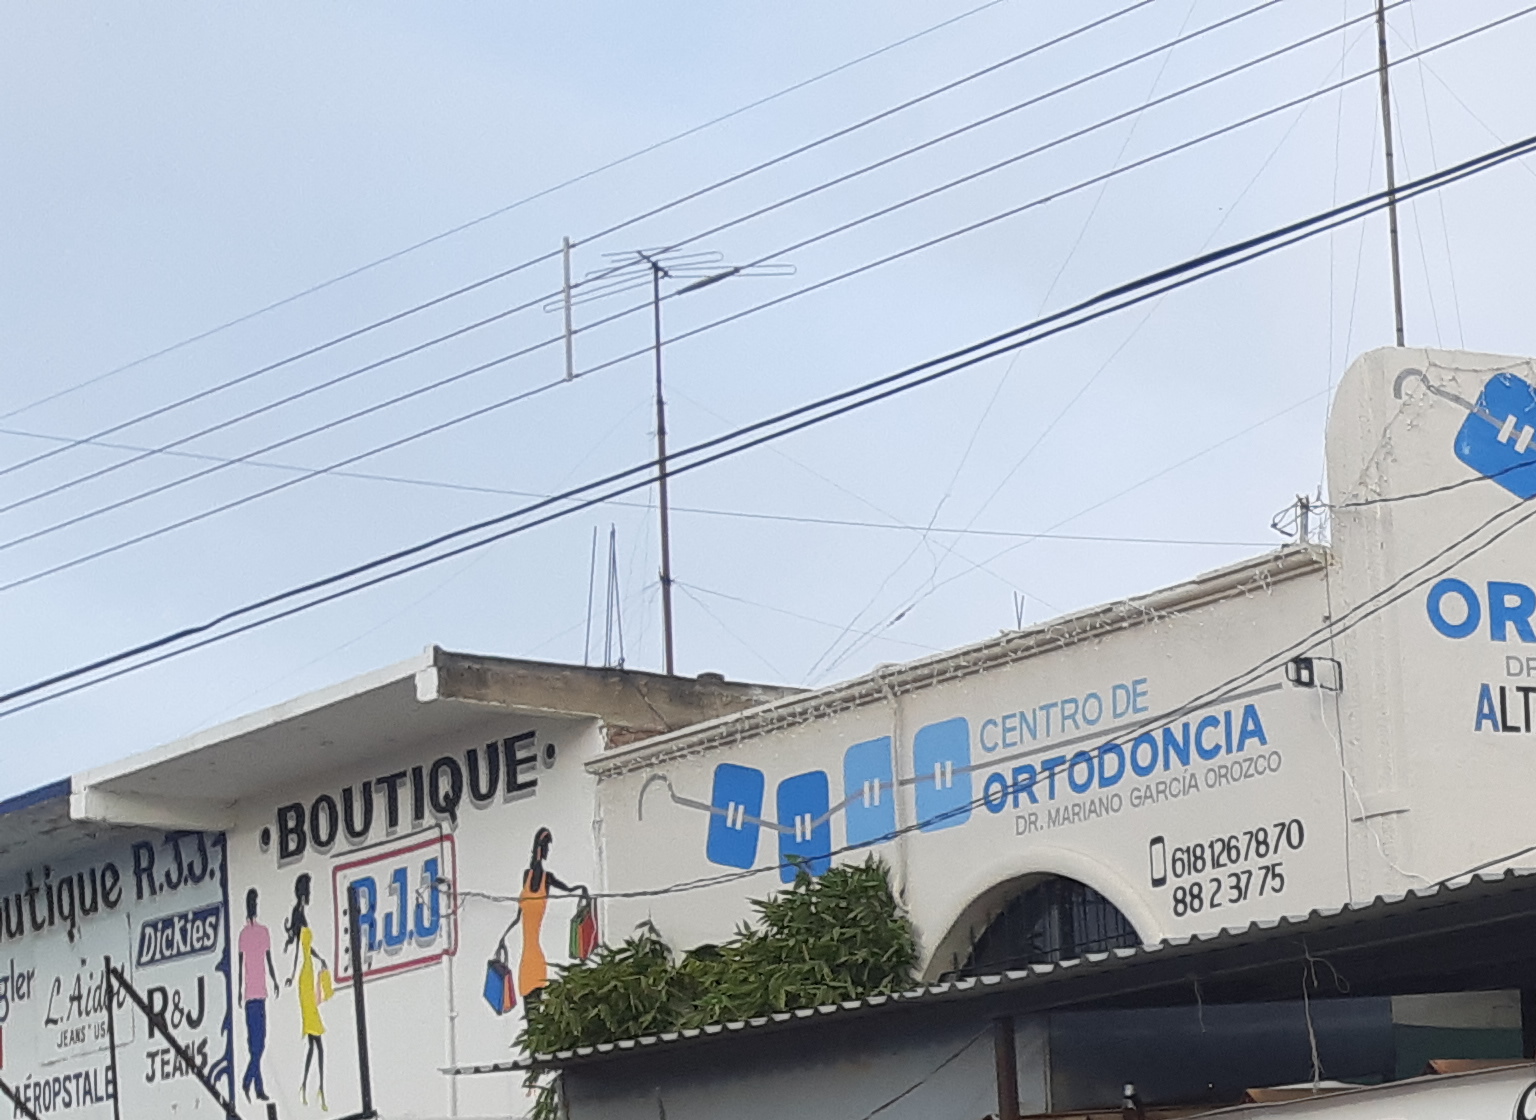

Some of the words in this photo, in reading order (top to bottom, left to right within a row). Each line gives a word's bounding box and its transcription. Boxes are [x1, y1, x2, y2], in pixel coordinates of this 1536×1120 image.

[979, 691, 1103, 754] CENTRO
[1111, 677, 1150, 718] DE
[276, 730, 541, 862] BOUTIQUE
[982, 702, 1269, 815] ORTODONCIA
[1014, 811, 1044, 838] DR.
[1045, 791, 1123, 831] MARIANO
[1129, 771, 1200, 810] GARCÍA
[1203, 750, 1283, 790] OROZCO
[0, 863, 123, 944] utique
[140, 912, 216, 965] Dickies
[56, 1025, 86, 1049] JEANS
[144, 1036, 209, 1083] JEANS
